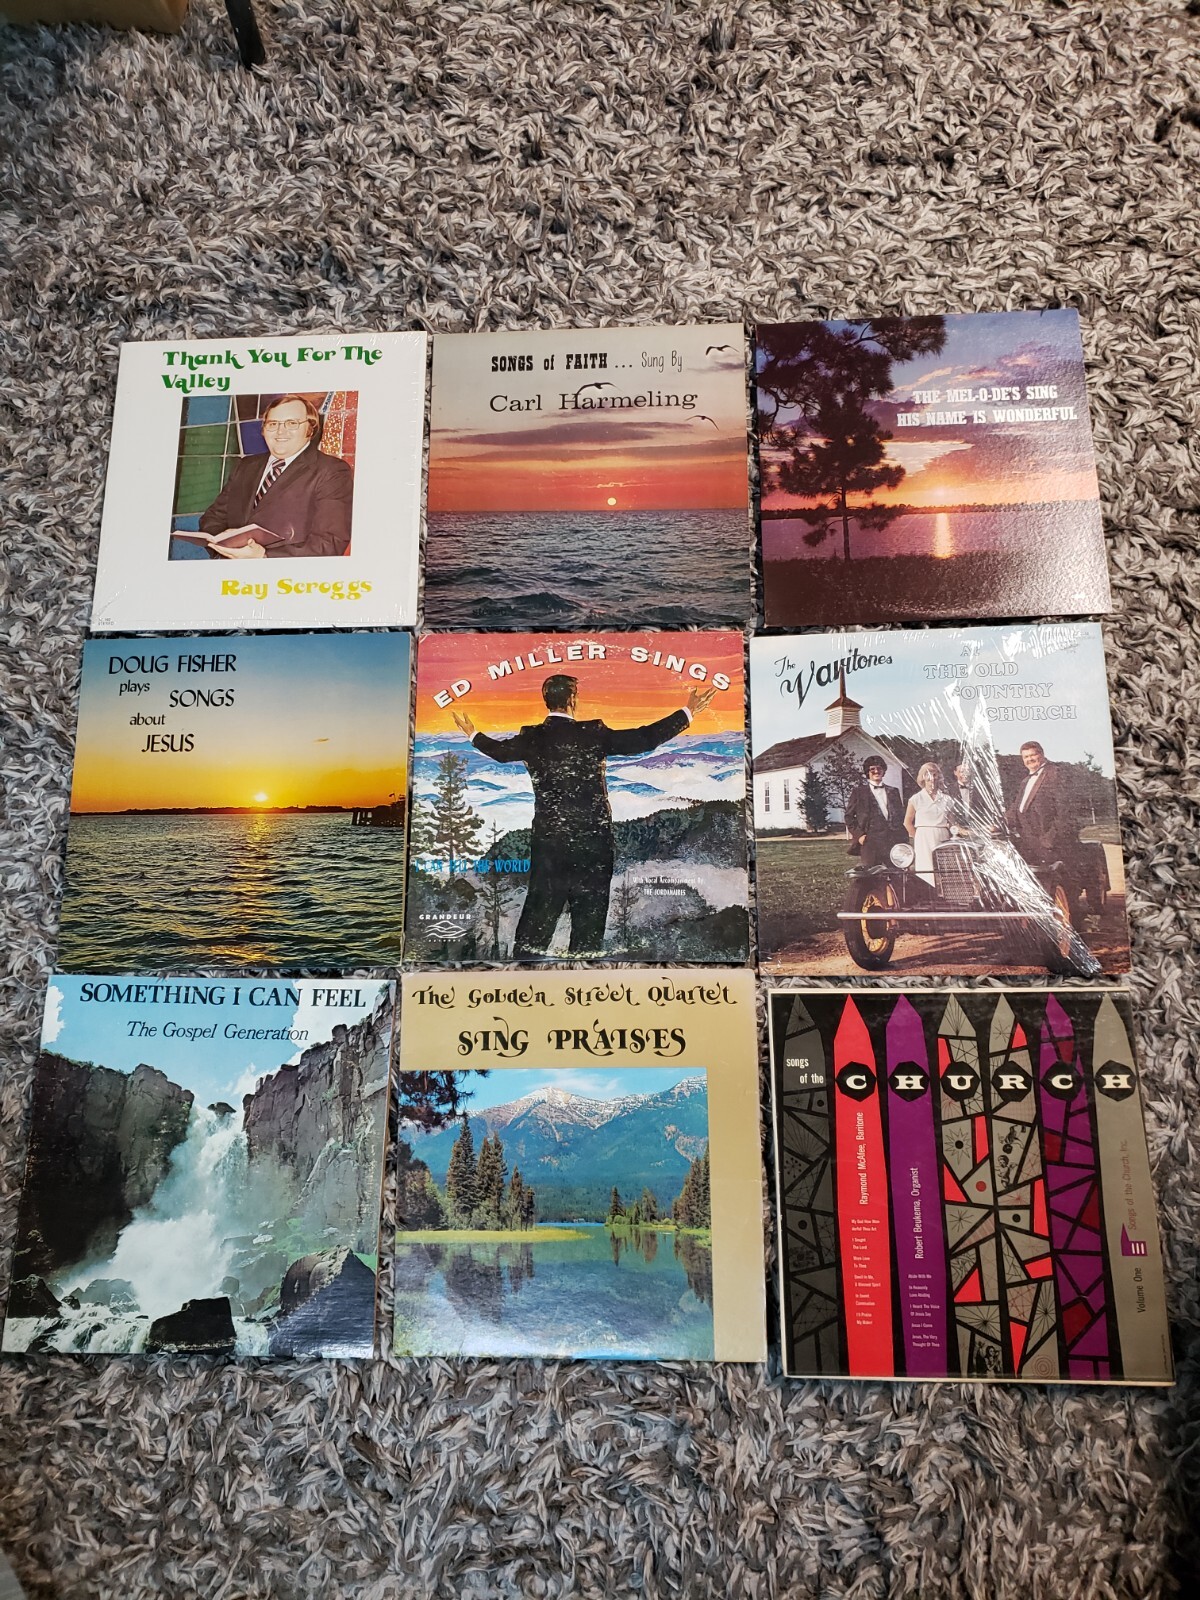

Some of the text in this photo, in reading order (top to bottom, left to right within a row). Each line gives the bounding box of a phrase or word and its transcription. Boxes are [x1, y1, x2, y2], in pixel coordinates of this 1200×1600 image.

[163, 346, 383, 370] Thank You For The
[491, 355, 534, 372] SONGS
[543, 354, 555, 370] of
[565, 353, 608, 369] FAITH
[641, 351, 664, 373] Sung
[671, 350, 683, 373] By
[161, 374, 231, 394] Valley
[912, 385, 1057, 404] THE MEL-O-DE'S SING
[489, 390, 698, 412] Carl Harmeling
[897, 406, 1078, 427] HIS NAME IS WONDERFUL
[221, 578, 372, 600] Ray Scroggs
[108, 654, 237, 674] DOUG FISHER
[774, 655, 796, 677] The
[923, 661, 1018, 679] THE OLD
[432, 643, 730, 710] ED MILLER SINGS
[119, 680, 150, 696] plays
[169, 688, 235, 707] SONGS
[129, 713, 165, 726] about
[987, 705, 1077, 722] CHURCH
[141, 733, 195, 753] JESUS
[494, 859, 531, 873] WORLD
[80, 983, 367, 1008] SOMETHING I CAN FEEL
[412, 977, 738, 1009] The Golden Street Quartet
[127, 1021, 309, 1041] The Gospel Generation
[457, 1016, 687, 1057] SING PRAISES
[786, 1058, 809, 1069] songs
[800, 1073, 808, 1084] of
[811, 1073, 824, 1084] the
[856, 1112, 865, 1141] Baritone
[859, 1173, 869, 1205] Raymond
[910, 1167, 924, 1259] Robert Beukema, Organist
[1128, 1208, 1137, 1230] Songs
[1133, 1267, 1146, 1313] Volume One
